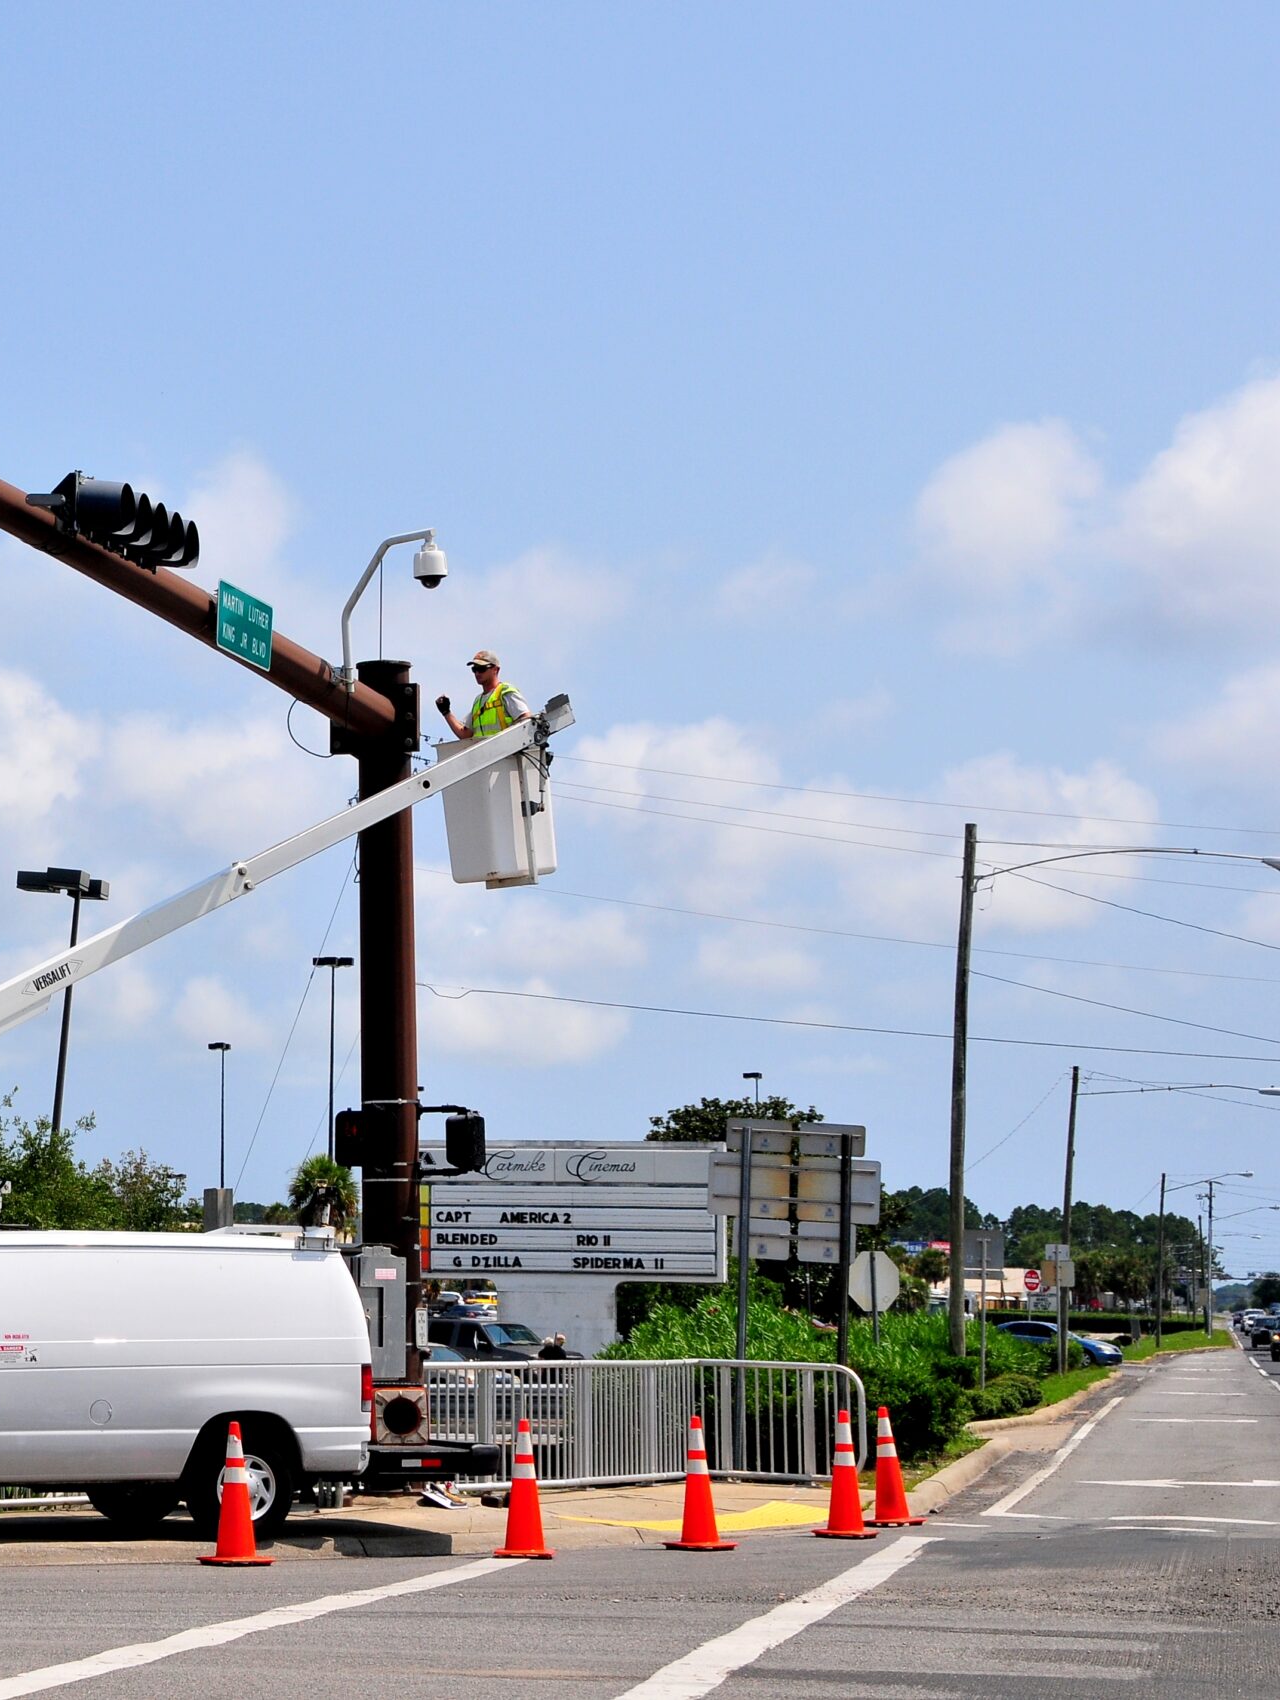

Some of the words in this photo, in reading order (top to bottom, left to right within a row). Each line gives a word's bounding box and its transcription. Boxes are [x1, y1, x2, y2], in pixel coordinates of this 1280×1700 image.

[222, 591, 245, 617] MARTIN
[248, 604, 270, 630] LUTHER
[222, 621, 236, 643] KING
[240, 632, 248, 649] JR
[251, 637, 267, 659] BLVD
[32, 962, 72, 992] VERSALIFT
[481, 1150, 547, 1181] Carmike
[565, 1151, 637, 1182] Cinemas
[436, 1211, 472, 1223] CAPT
[499, 1211, 560, 1224] AMERICA
[563, 1213, 572, 1225] 2
[436, 1233, 498, 1246] BLENDED
[577, 1235, 599, 1247] RIO
[603, 1235, 611, 1247] II
[453, 1256, 462, 1268] G
[471, 1256, 522, 1269] DZILLA
[572, 1257, 645, 1270] SPIDERMA
[654, 1258, 665, 1270] II
